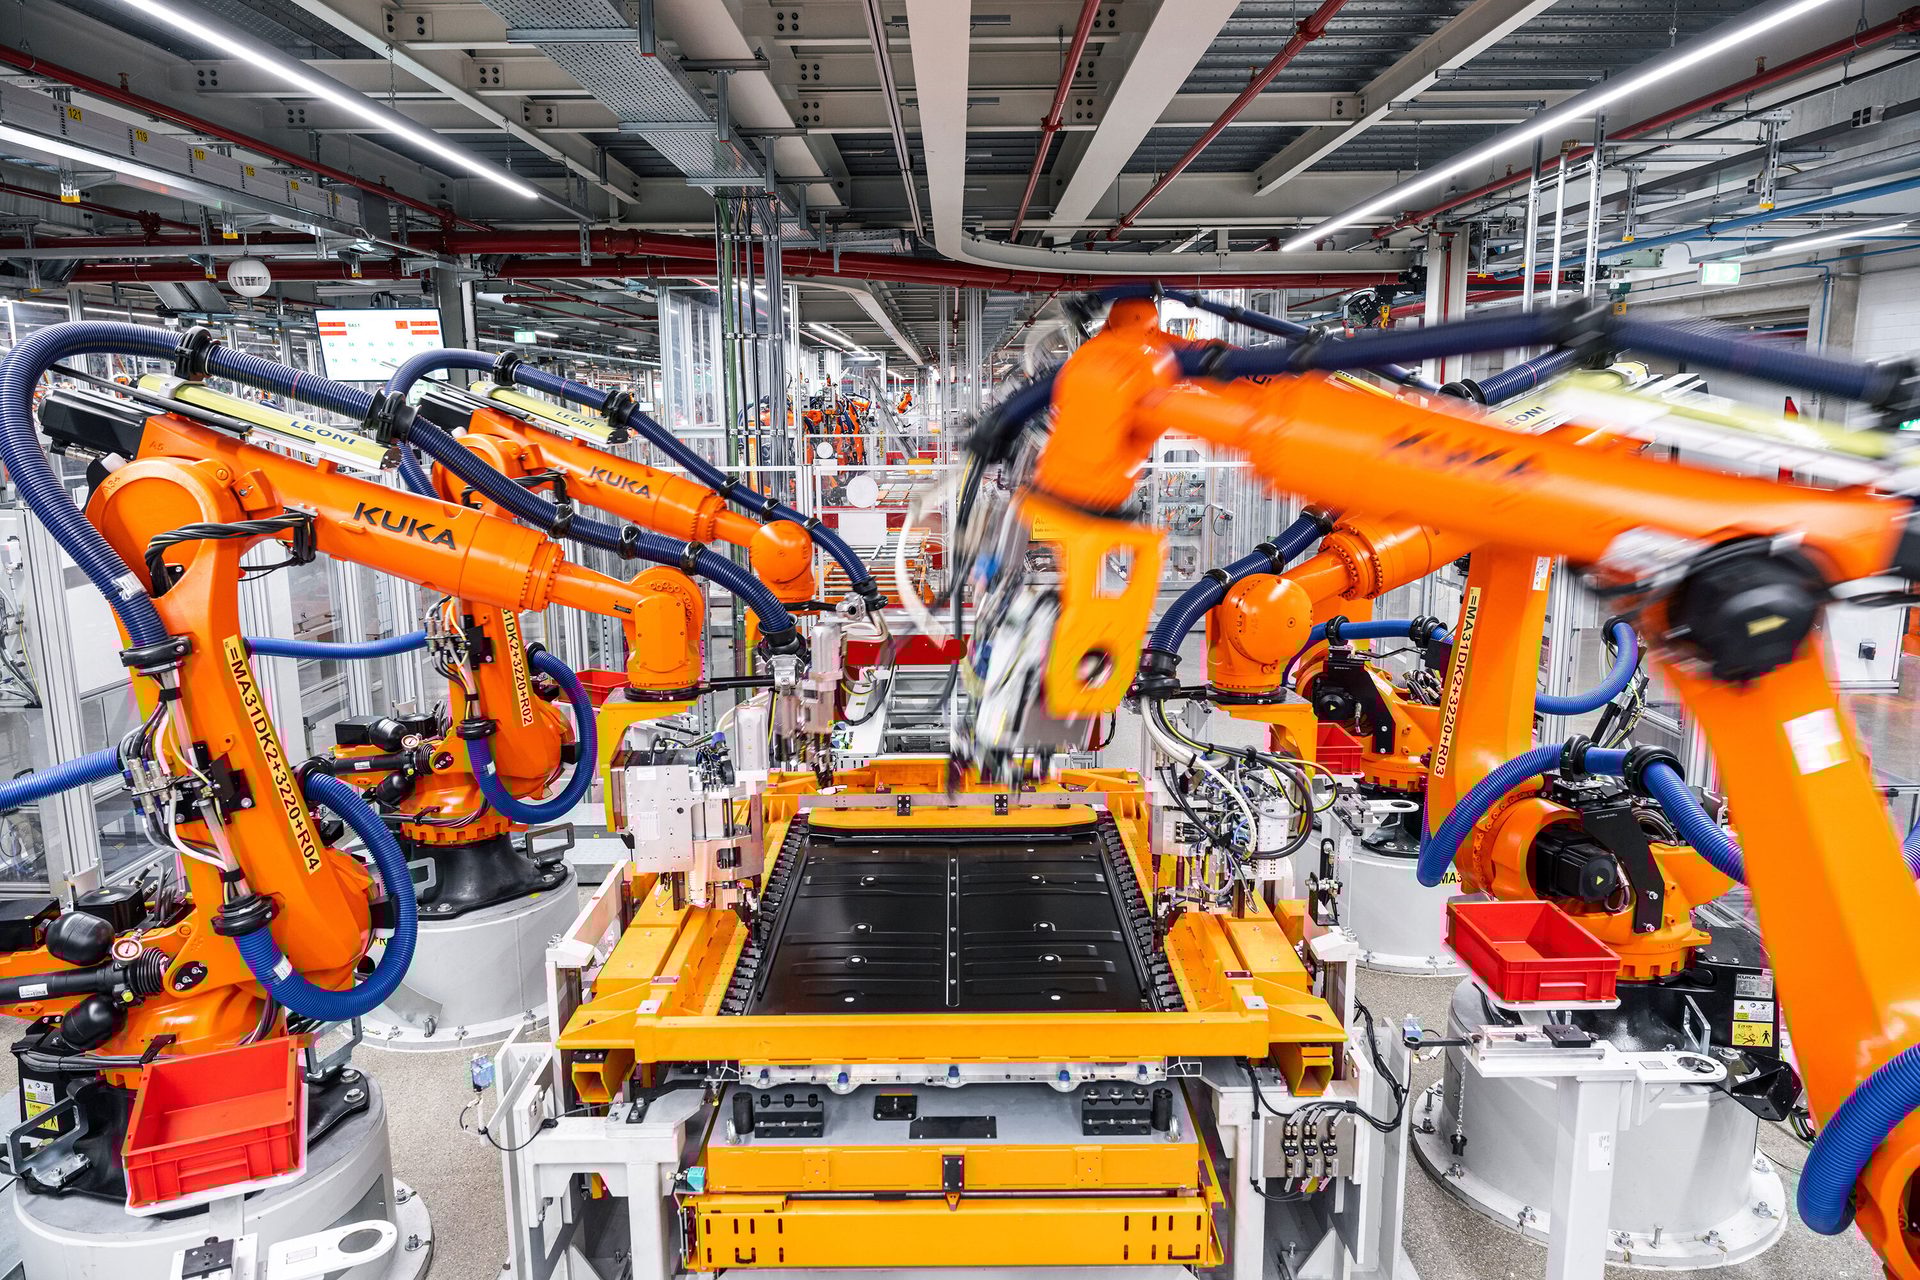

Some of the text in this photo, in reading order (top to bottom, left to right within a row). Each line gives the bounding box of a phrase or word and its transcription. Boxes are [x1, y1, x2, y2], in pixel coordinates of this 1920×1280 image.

[68, 107, 82, 121] 121
[136, 130, 148, 142] 119
[195, 149, 204, 160] 117
[556, 411, 595, 428] LEONI
[1501, 406, 1547, 428] EONI
[290, 421, 356, 445] LEONI
[589, 466, 650, 499] KUKA
[353, 502, 456, 550] KUKA
[1436, 595, 1477, 776] =MA31DK2+3220+R03
[229, 646, 321, 870] =MA31DK2+3220+R04
